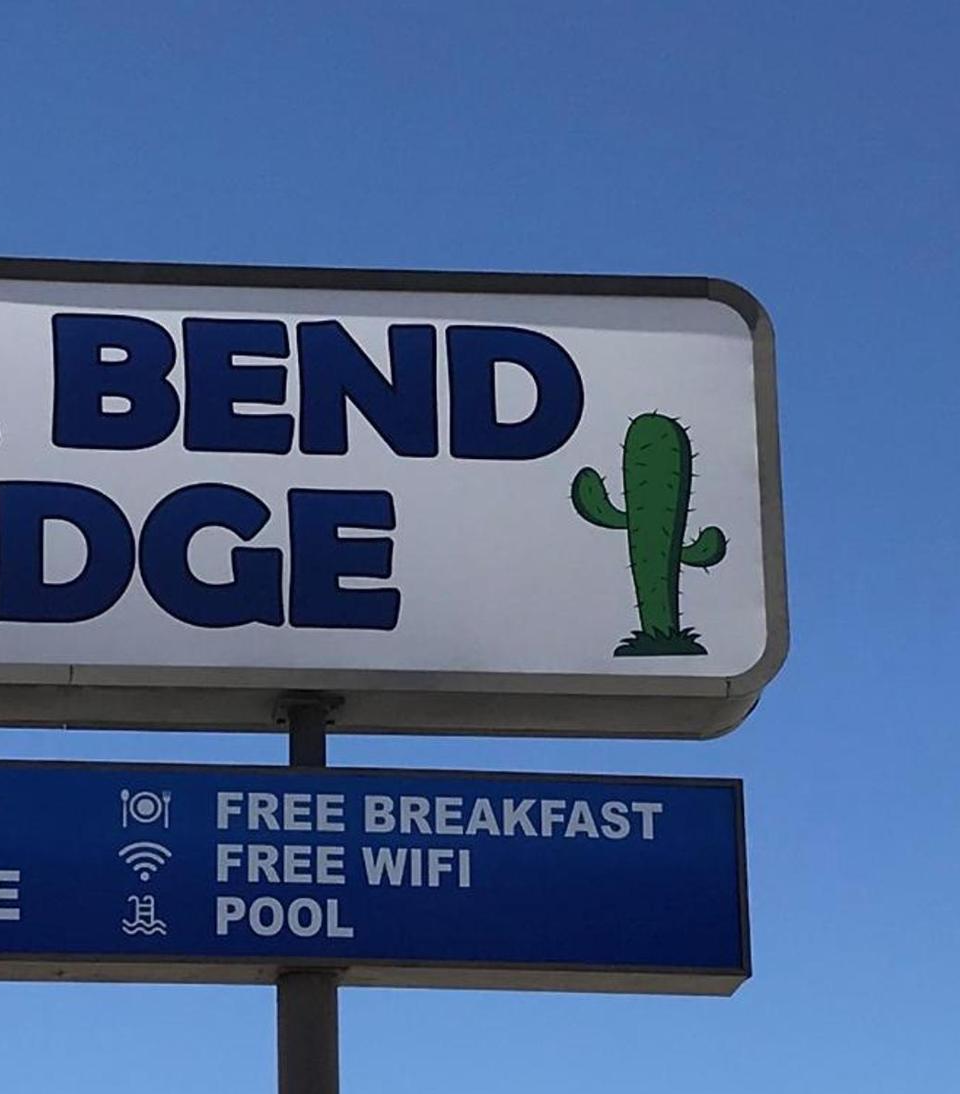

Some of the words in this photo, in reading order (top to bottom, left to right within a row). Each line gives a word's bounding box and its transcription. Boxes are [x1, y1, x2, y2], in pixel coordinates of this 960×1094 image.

[52, 314, 584, 460] BEND
[217, 792, 345, 832] FREE
[364, 795, 664, 840] BREAKFAST
[217, 844, 345, 884] FREE
[362, 847, 470, 887] WIFI
[217, 897, 354, 938] POOL
